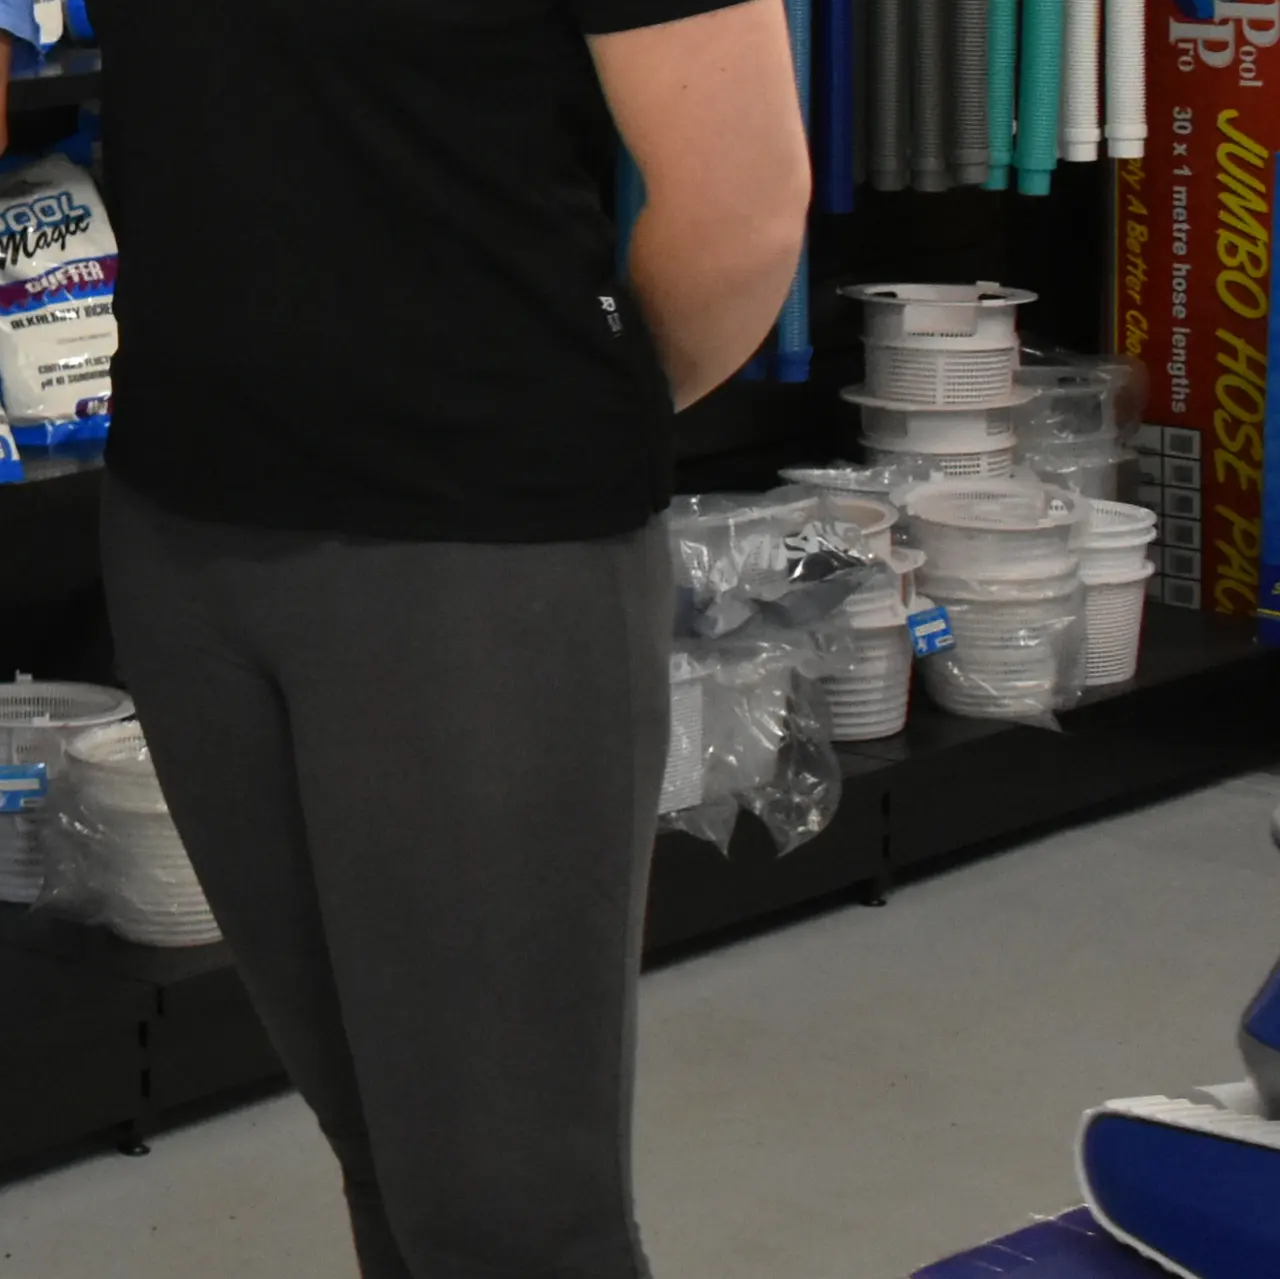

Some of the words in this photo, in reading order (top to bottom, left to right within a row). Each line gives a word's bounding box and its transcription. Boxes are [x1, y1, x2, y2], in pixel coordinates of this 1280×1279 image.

[1169, 17, 1237, 72] Pro
[1172, 106, 1193, 135] 30
[1172, 185, 1192, 256] metre
[1215, 109, 1270, 319] JUMBO
[24, 260, 105, 294] BUFFER
[1125, 220, 1149, 305] Better
[1171, 260, 1192, 319] hose
[1166, 326, 1192, 414] lengths
[1213, 328, 1268, 491] HOSE
[1213, 504, 1262, 617] PAC
